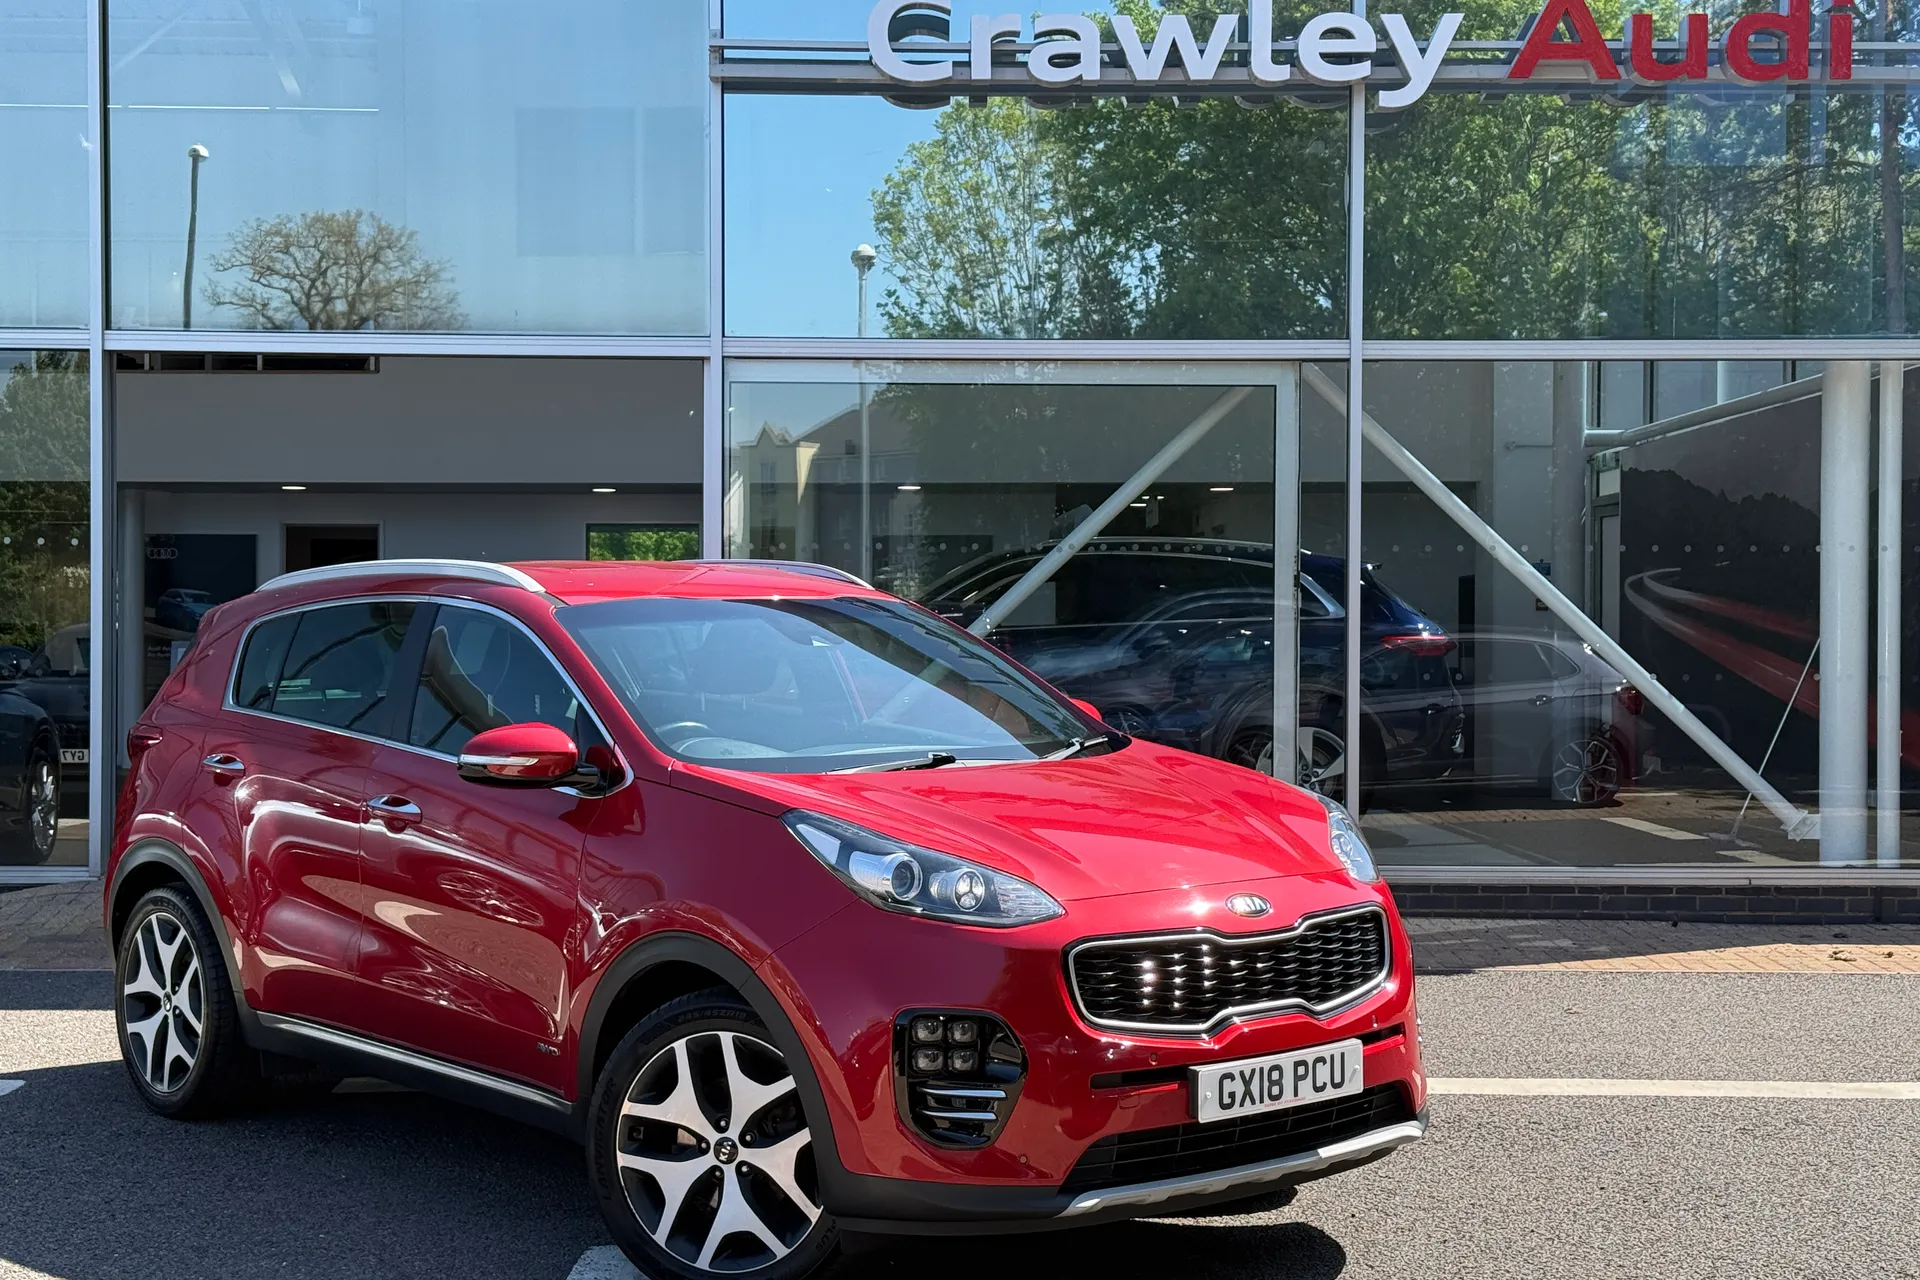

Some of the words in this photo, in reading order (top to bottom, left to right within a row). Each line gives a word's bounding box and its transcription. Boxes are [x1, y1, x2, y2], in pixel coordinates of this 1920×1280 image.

[867, 0, 1464, 107] Crawley
[1507, 0, 1853, 81] Audi
[1218, 1064, 1284, 1110] GX18
[1293, 1052, 1345, 1098] PCU
